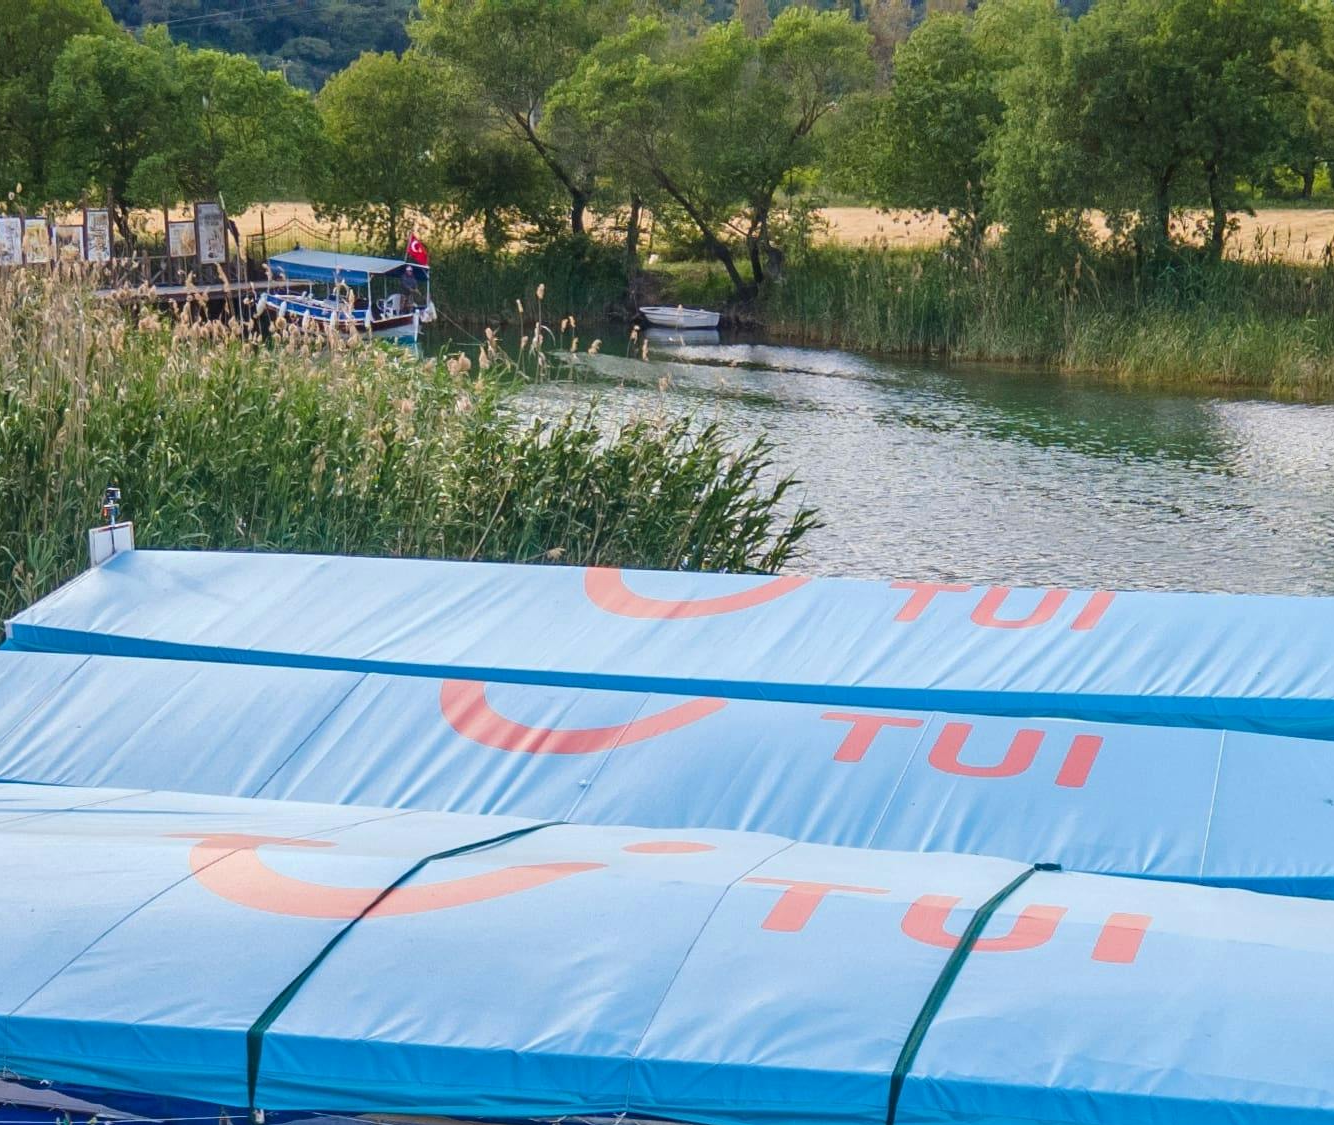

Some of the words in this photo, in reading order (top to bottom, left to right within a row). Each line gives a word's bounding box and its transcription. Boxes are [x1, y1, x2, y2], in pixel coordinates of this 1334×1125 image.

[889, 582, 1116, 631] TUI
[820, 712, 1104, 787] TUI
[742, 877, 1153, 964] TUI
